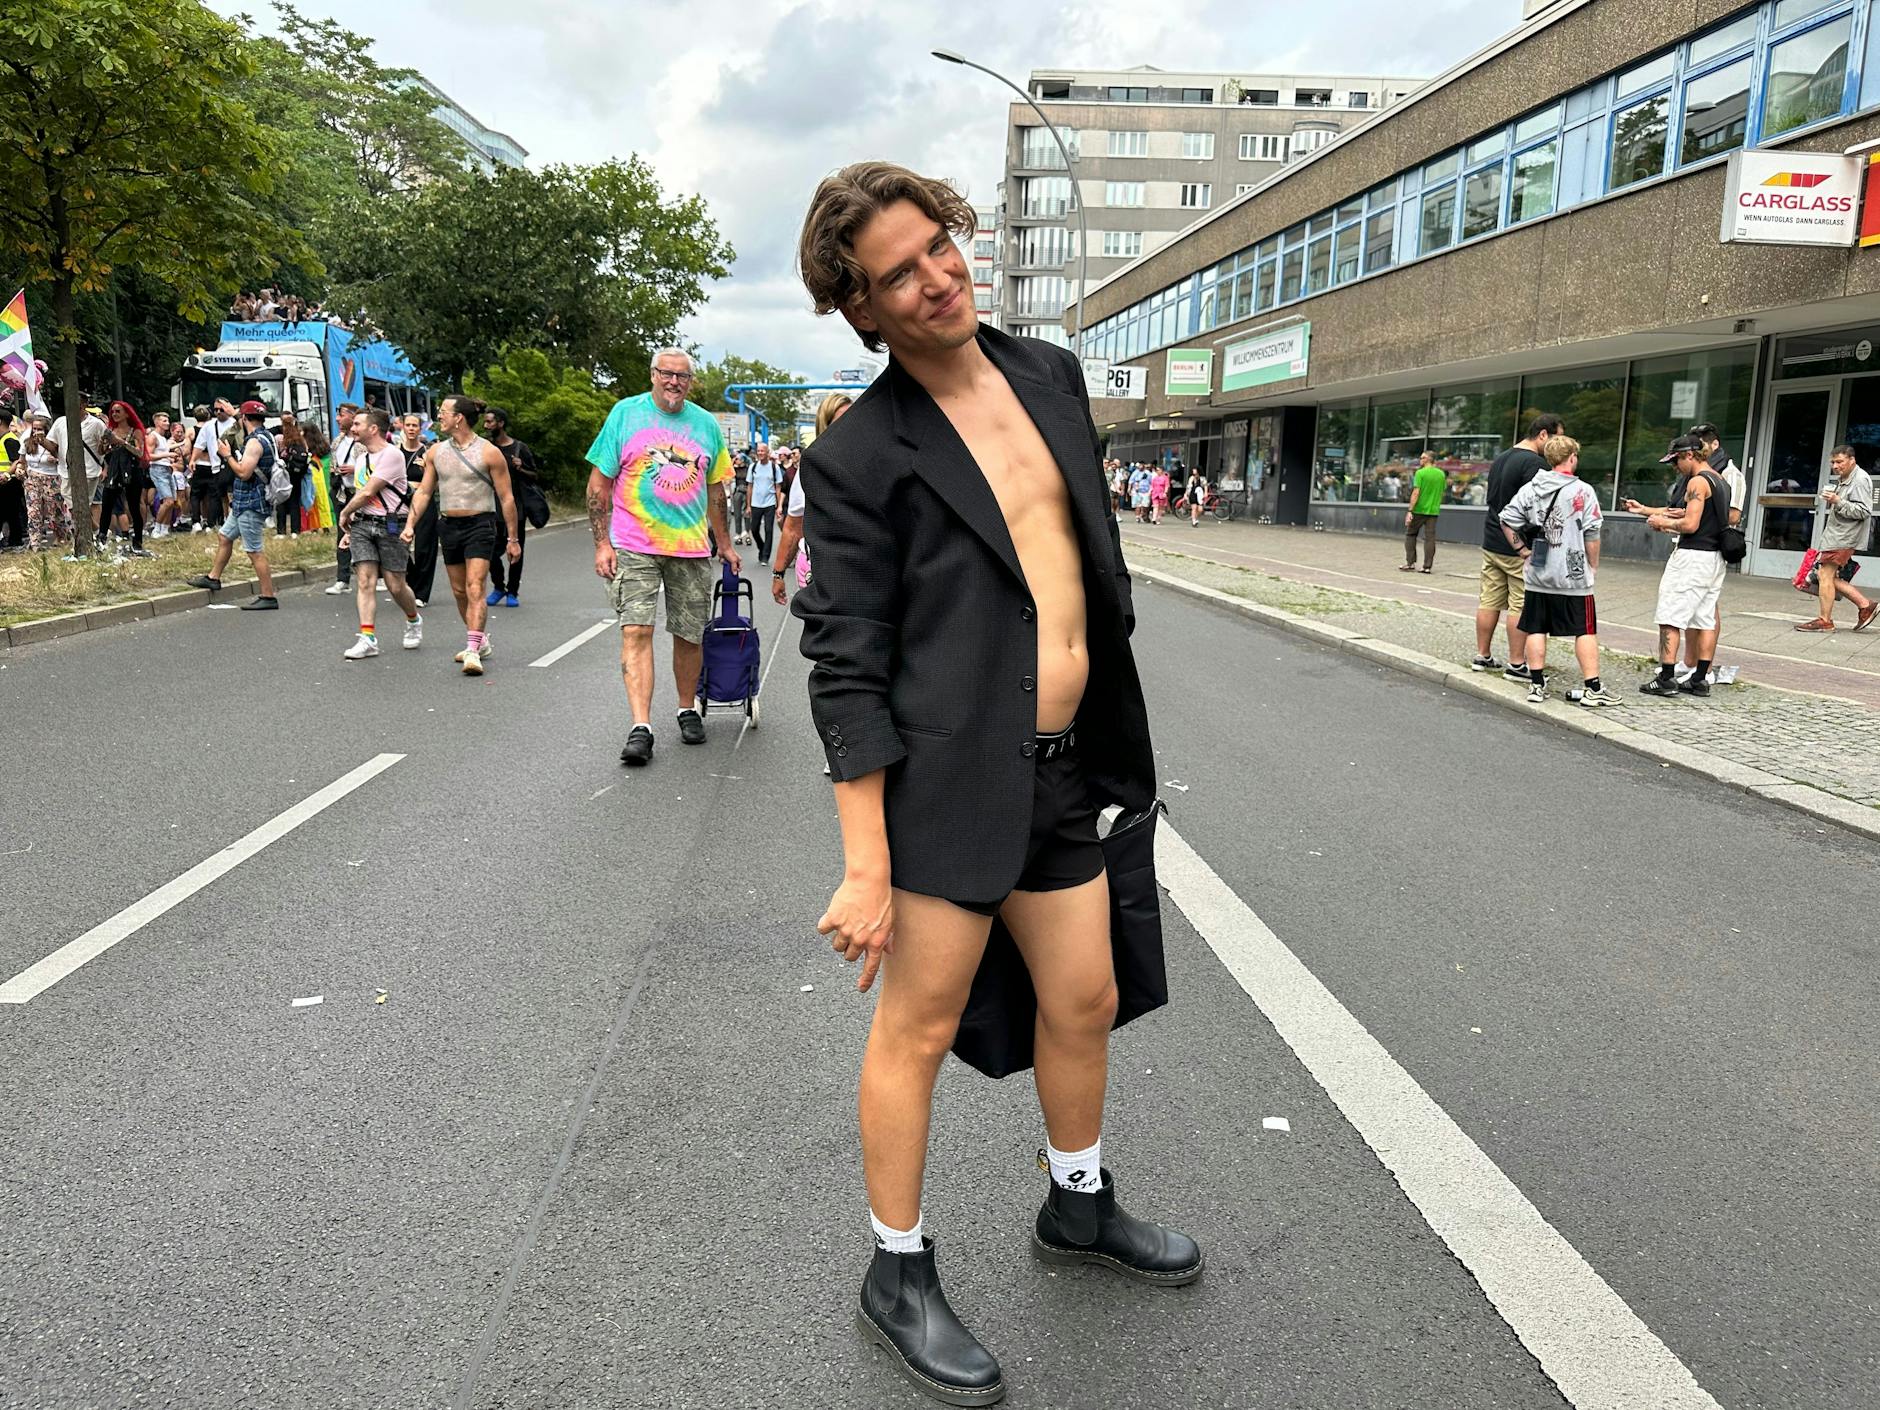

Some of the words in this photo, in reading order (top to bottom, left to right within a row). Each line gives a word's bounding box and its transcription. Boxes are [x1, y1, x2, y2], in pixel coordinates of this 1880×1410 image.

[1739, 192, 1852, 212] CARGLASS
[1743, 214, 1762, 222] WENN
[235, 327, 264, 337] Mehr
[1233, 339, 1294, 366] WILLKOMMENSZENTRUM
[1108, 369, 1131, 388] P61
